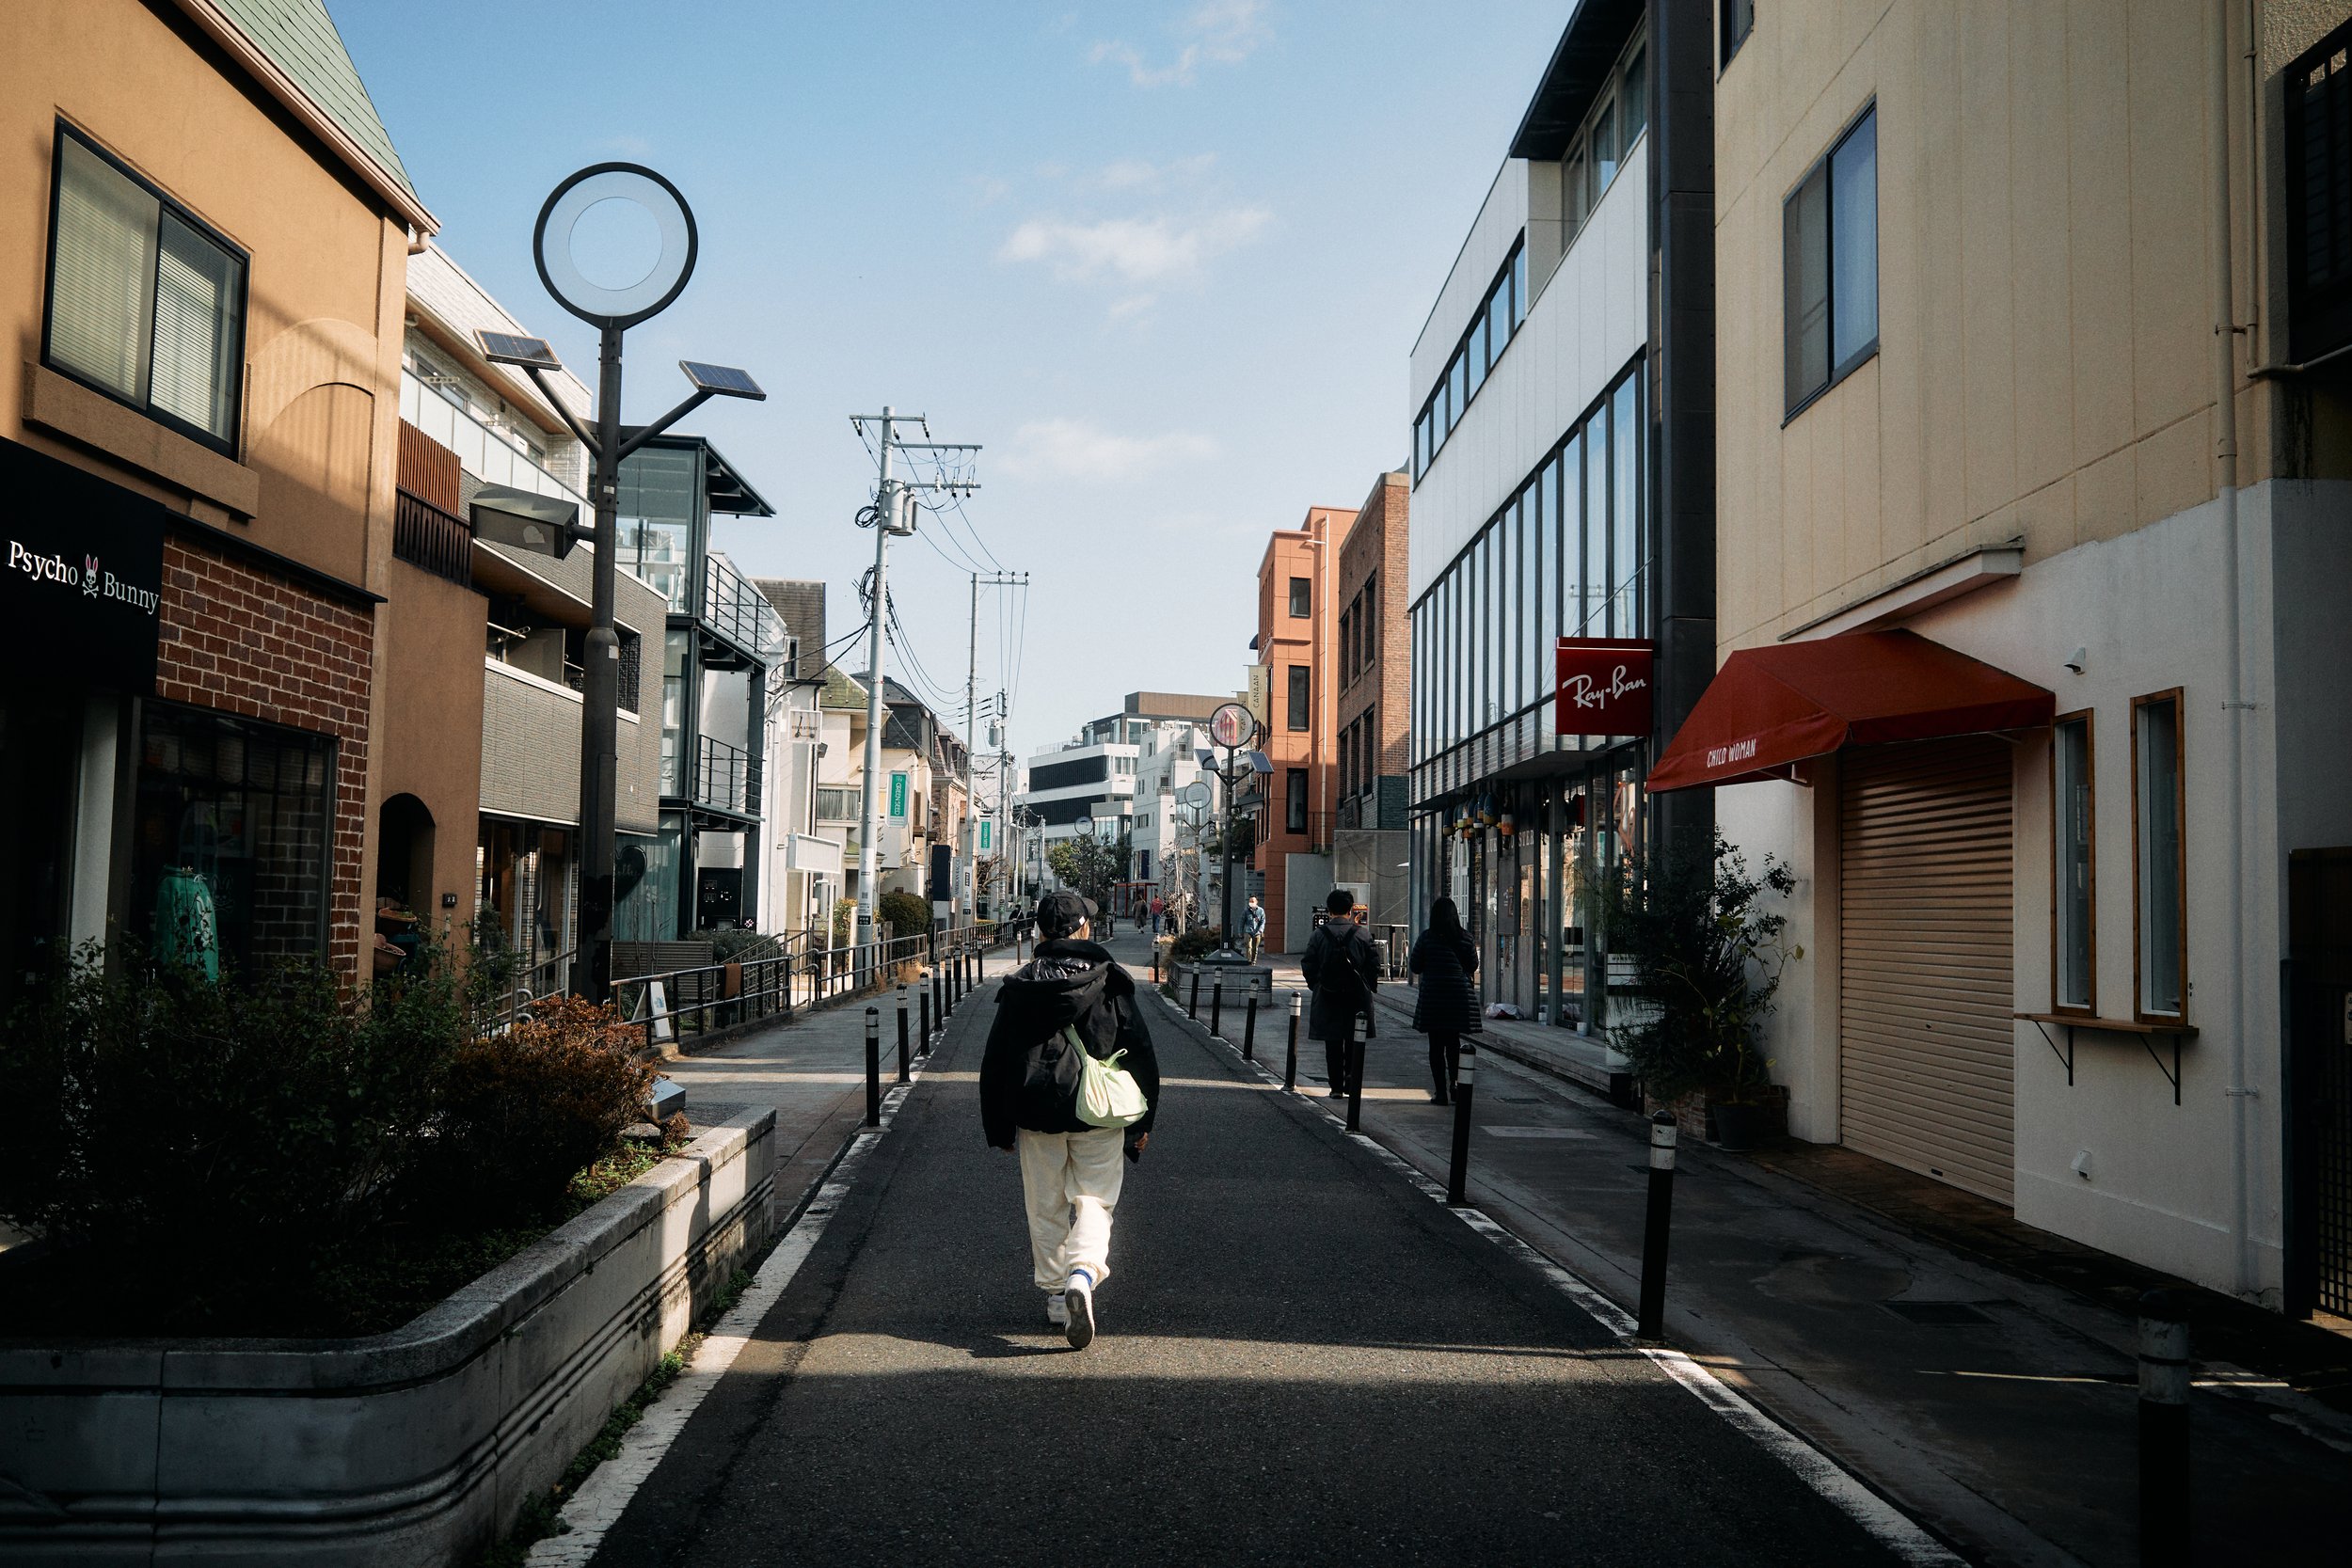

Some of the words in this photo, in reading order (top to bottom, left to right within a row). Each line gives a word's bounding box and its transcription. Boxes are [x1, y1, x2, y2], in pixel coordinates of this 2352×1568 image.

[8, 540, 78, 585] Psycho
[103, 571, 159, 615] Bunny
[1707, 747, 1726, 768] CHILD
[1728, 738, 1756, 763] WOMAN
